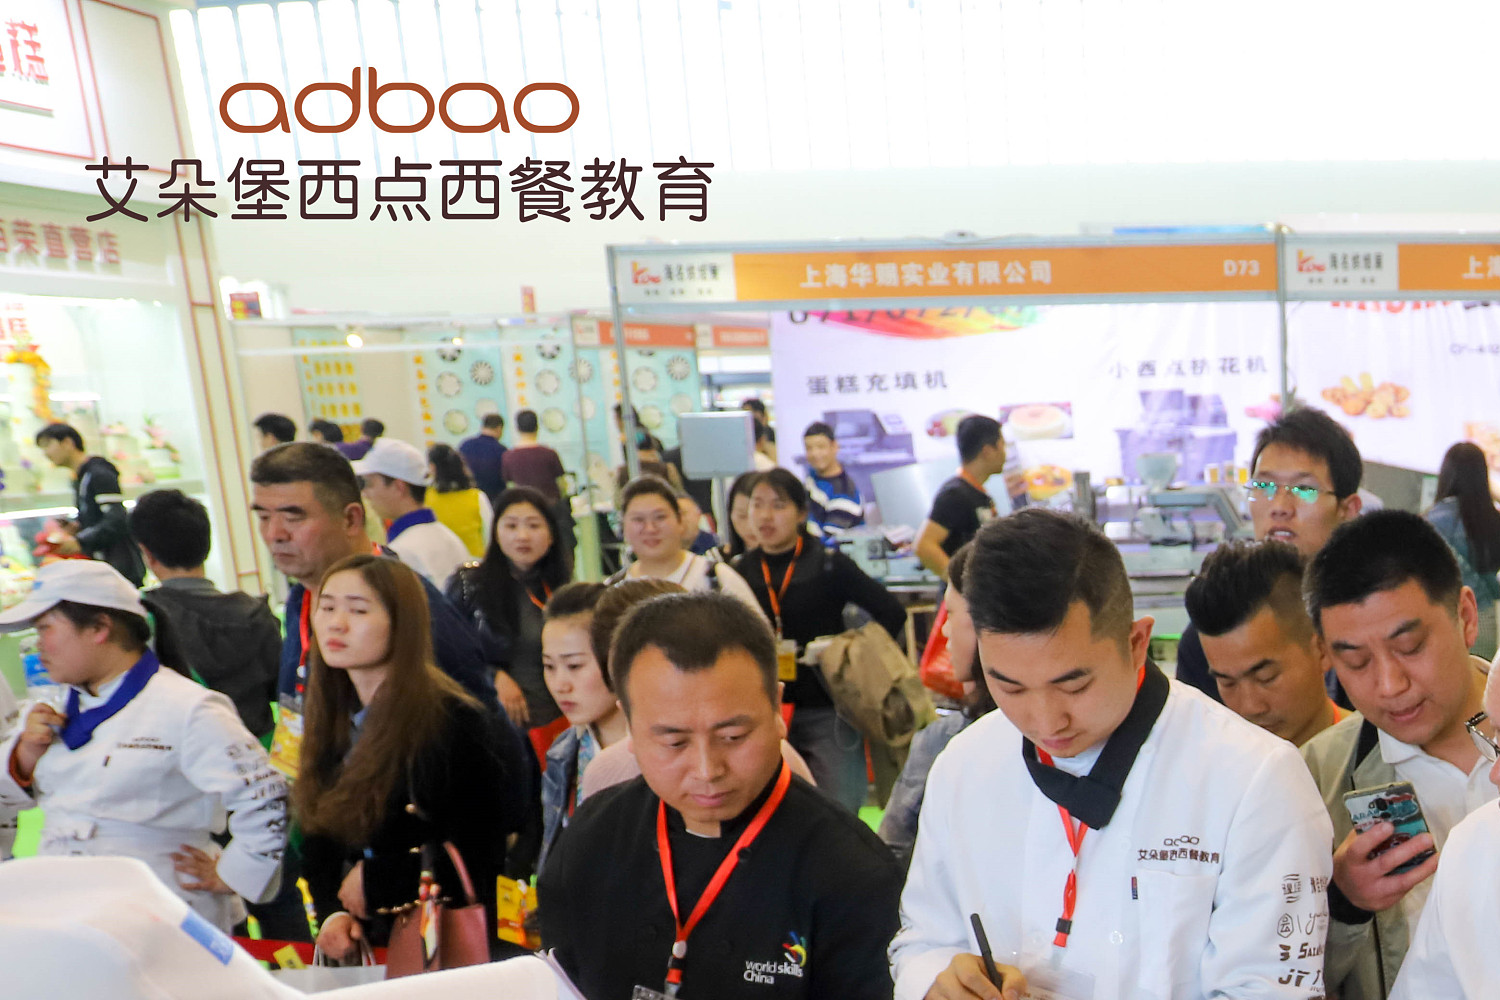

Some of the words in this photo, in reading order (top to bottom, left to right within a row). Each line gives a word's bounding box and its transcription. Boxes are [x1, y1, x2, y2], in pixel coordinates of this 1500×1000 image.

[1223, 259, 1260, 277] D73
[806, 371, 948, 394] 蛋糕充填机
[743, 969, 775, 985] China
